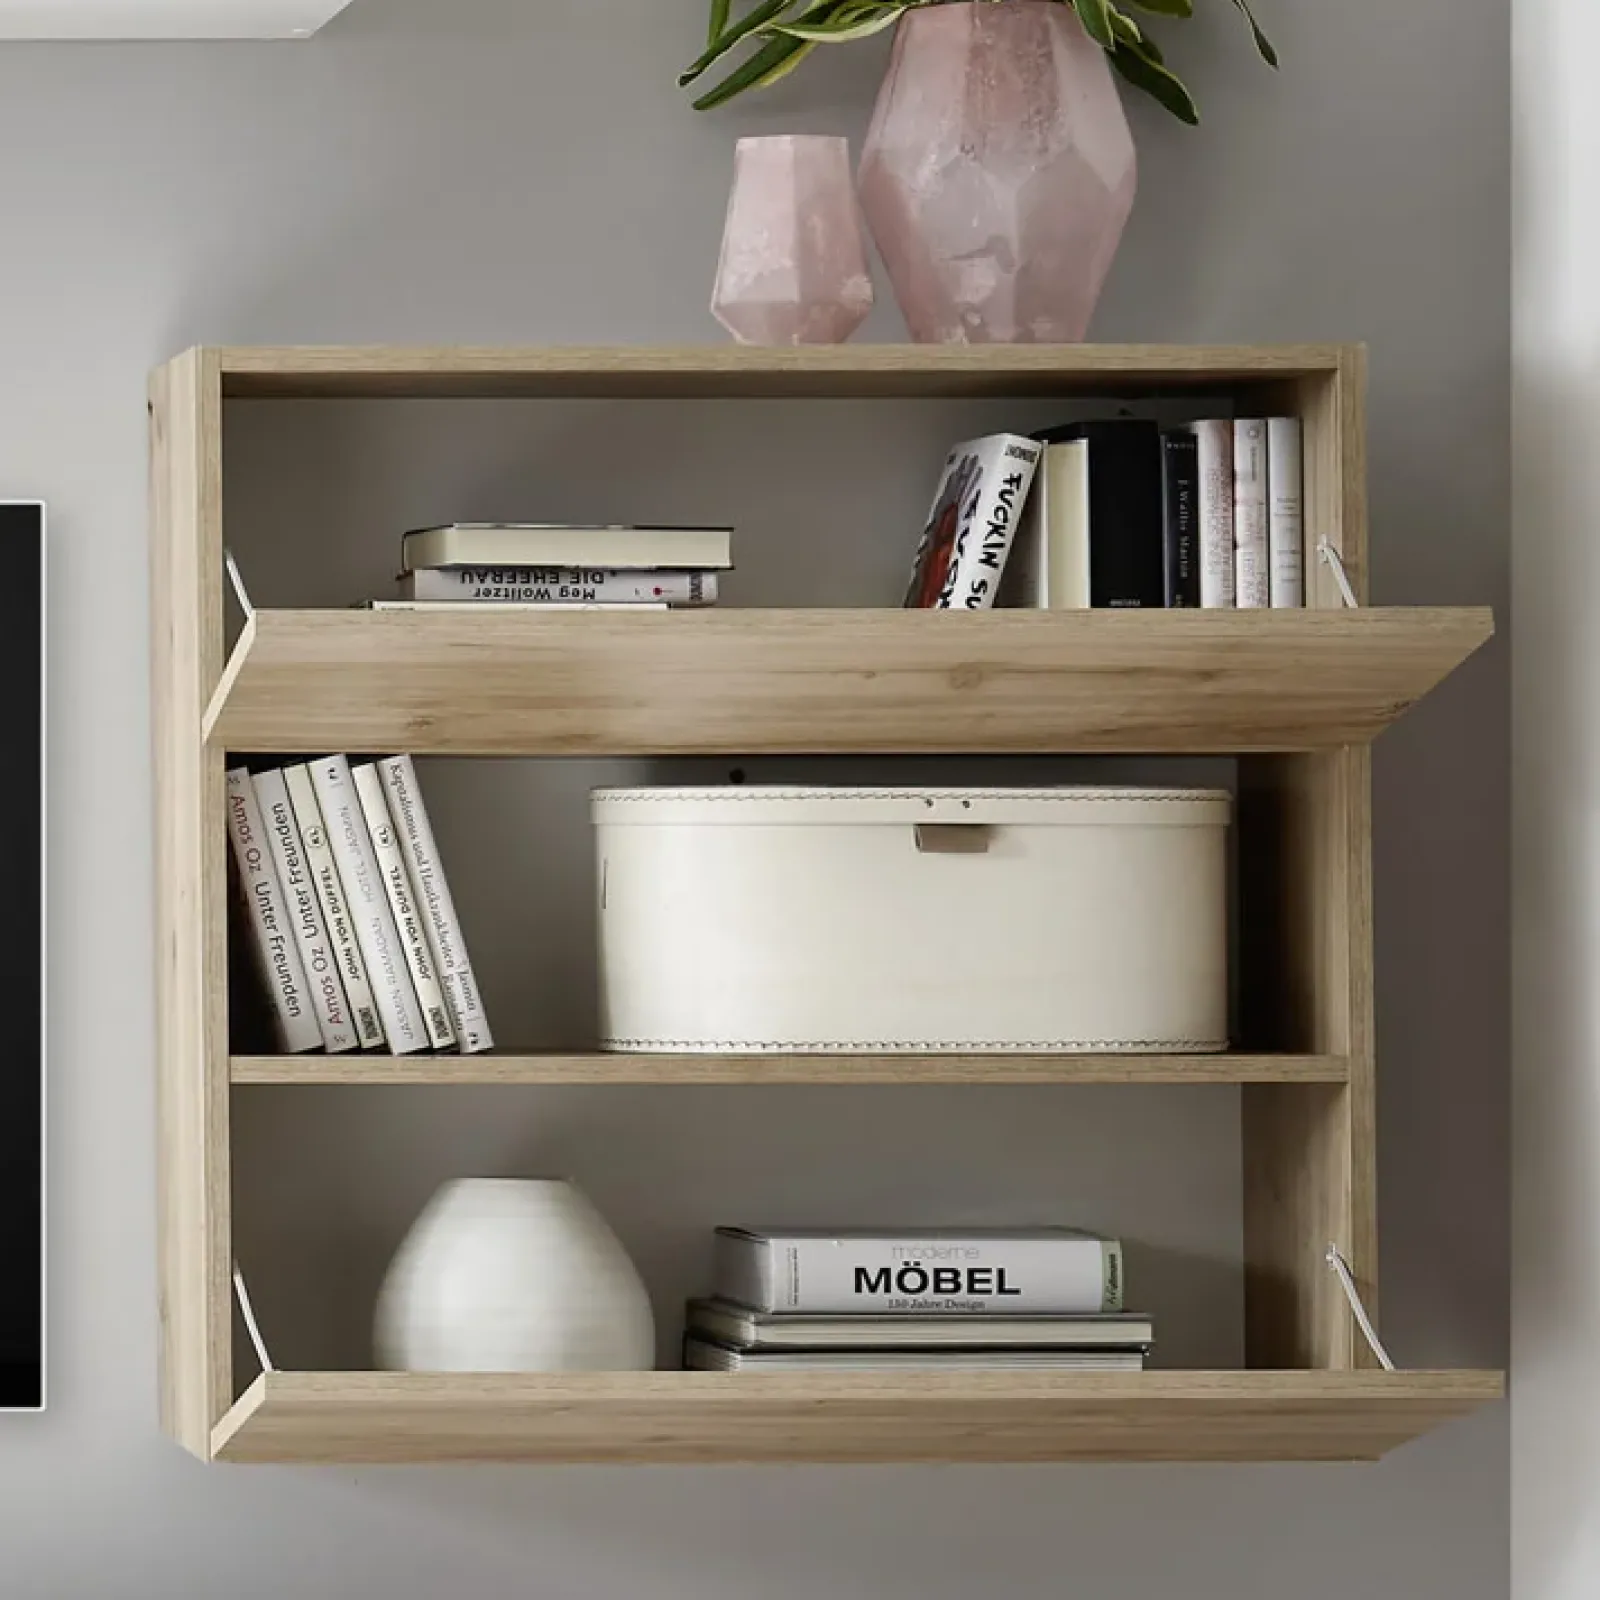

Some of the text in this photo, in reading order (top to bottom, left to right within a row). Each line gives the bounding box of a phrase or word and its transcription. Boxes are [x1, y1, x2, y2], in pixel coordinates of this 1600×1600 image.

[979, 472, 1022, 569] FUCKIN
[461, 571, 604, 584] DIE EHEFRAU
[474, 586, 595, 600] Meg Wolitzer
[271, 803, 304, 884] Freunden
[230, 795, 253, 844] Amos
[246, 848, 261, 872] Oz
[255, 881, 277, 939] Unter
[269, 932, 302, 1017] Freunden
[296, 881, 319, 939] Unter
[333, 915, 350, 945] VON
[403, 916, 419, 945] VON
[311, 946, 327, 972] Oz
[341, 946, 361, 980] JOHN
[412, 946, 431, 980] JOHN
[320, 976, 344, 1024] Amos
[892, 1245, 979, 1260] moderne
[854, 1260, 1021, 1295] MÖBEL
[910, 1299, 941, 1309] Jahre
[944, 1299, 986, 1311] Design
